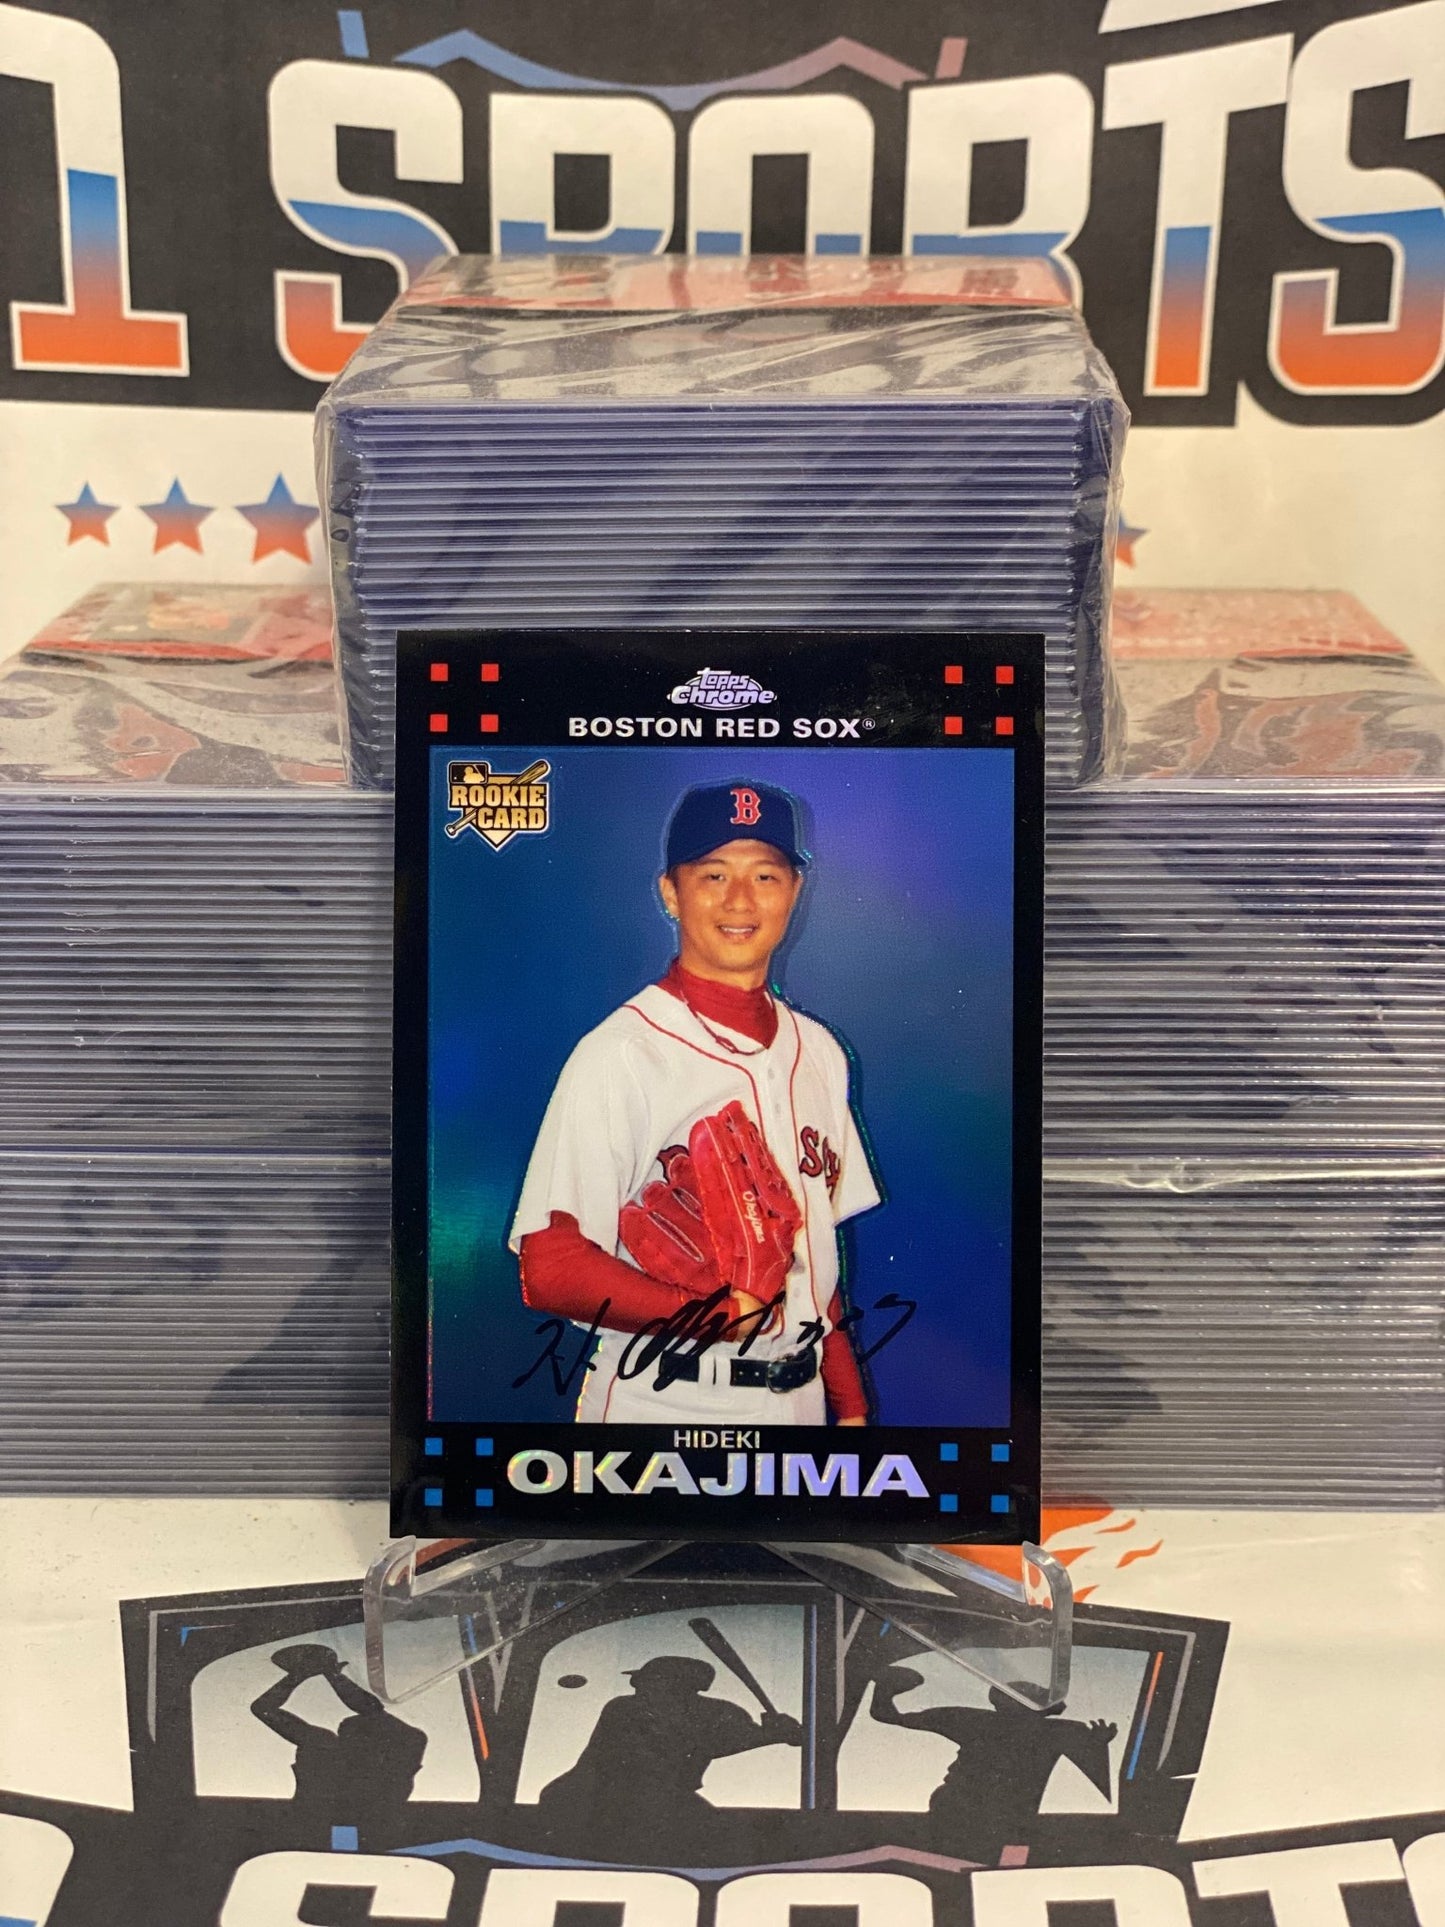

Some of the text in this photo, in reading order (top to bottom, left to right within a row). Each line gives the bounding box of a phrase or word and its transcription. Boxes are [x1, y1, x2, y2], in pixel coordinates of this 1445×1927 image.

[267, 0, 1445, 396] SPORTS
[671, 685, 775, 705] Chrome
[567, 716, 703, 739] BOSTON
[715, 717, 781, 738] RED
[450, 784, 546, 807] ROOKIE
[730, 787, 762, 826] B
[477, 807, 546, 830] CARD
[673, 1429, 762, 1450] HIDEKI
[506, 1449, 931, 1499] OKAJIMA
